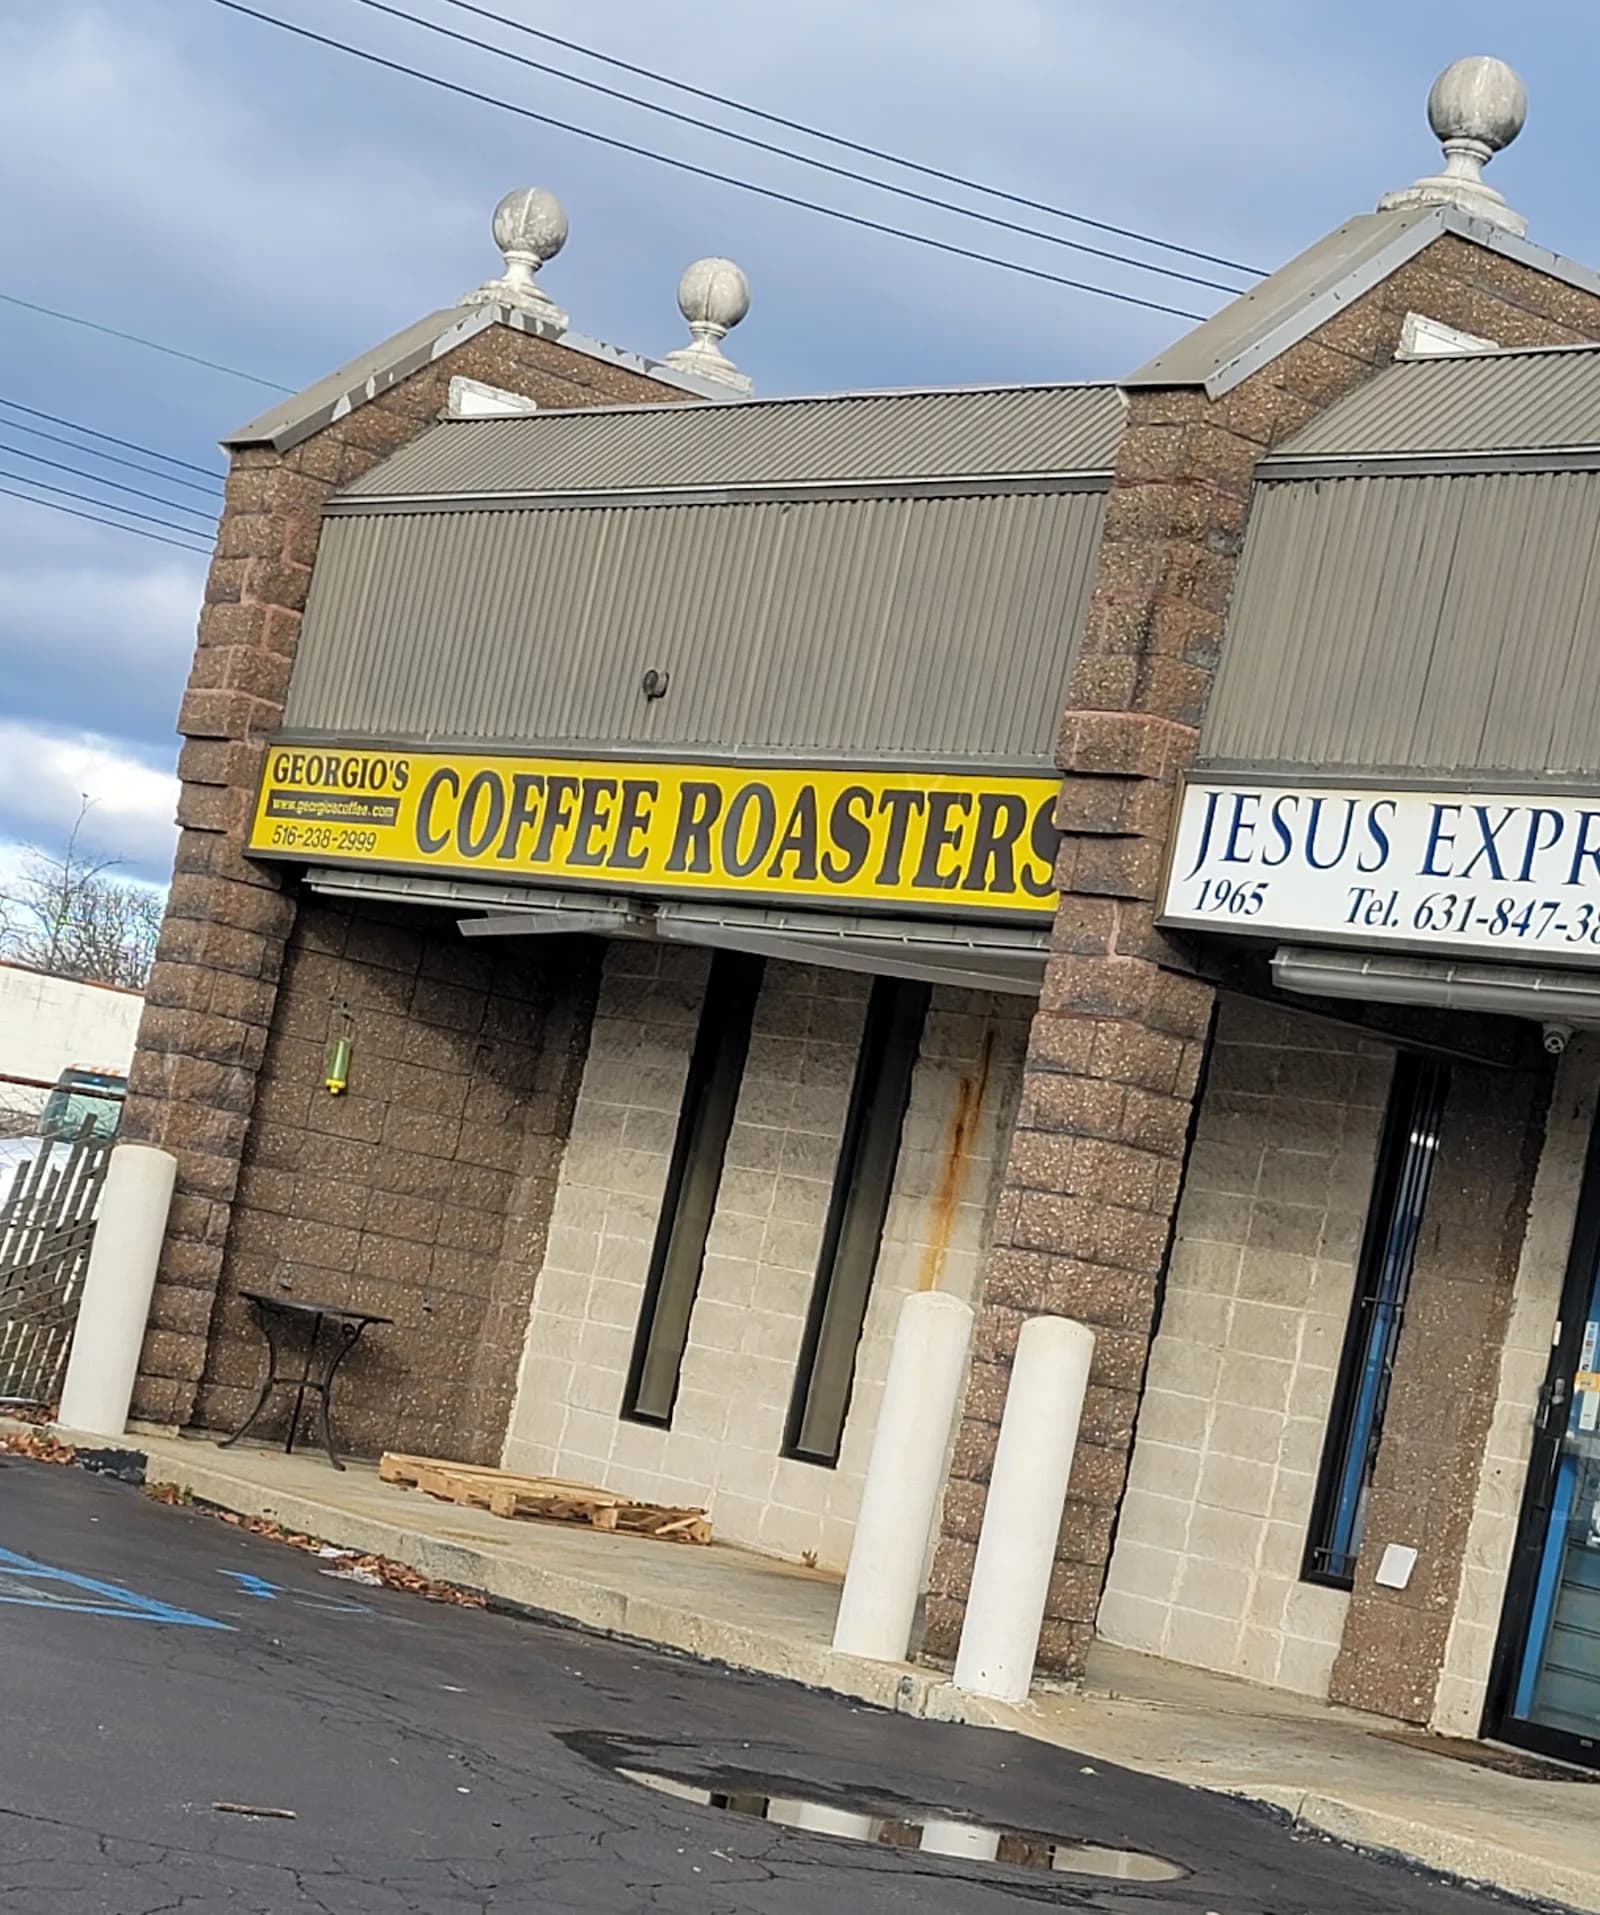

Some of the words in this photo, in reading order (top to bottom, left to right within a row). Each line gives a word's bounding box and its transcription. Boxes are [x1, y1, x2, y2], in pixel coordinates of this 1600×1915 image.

[273, 753, 409, 791] GEORGIO'S
[272, 824, 377, 852] 516-238-2999
[415, 767, 659, 868] COFFEE
[664, 782, 1061, 897] ROASTERS
[1183, 791, 1397, 881] JESUS
[1415, 803, 1600, 887] EXPR
[1192, 878, 1270, 915] 1965
[1344, 886, 1400, 928] Tel.
